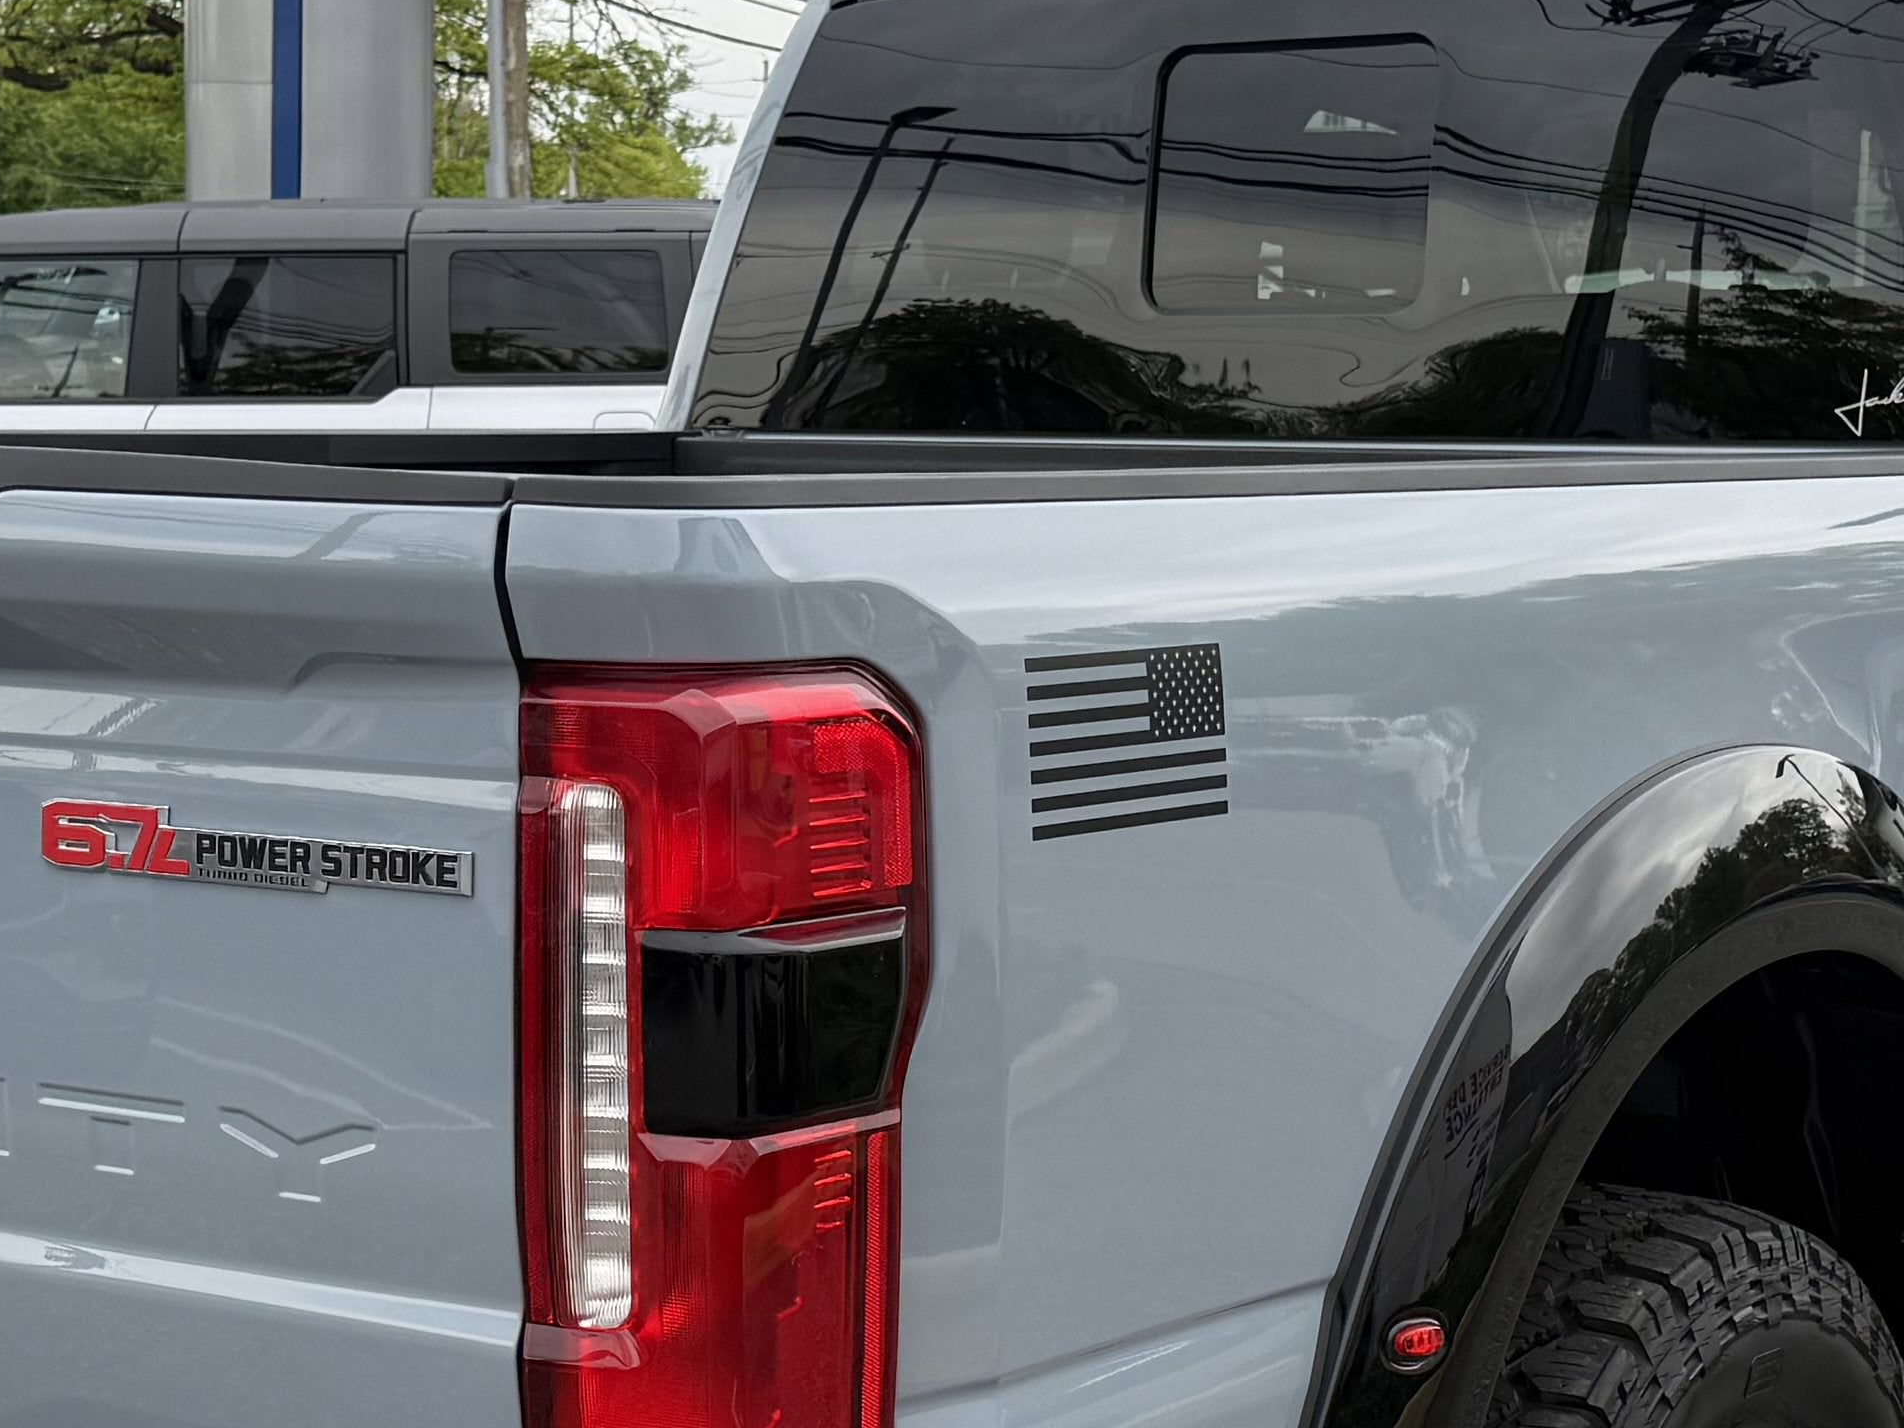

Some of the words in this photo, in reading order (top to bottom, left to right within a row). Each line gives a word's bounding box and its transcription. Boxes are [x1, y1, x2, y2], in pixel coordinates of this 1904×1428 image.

[41, 799, 191, 876] 6.7L
[197, 832, 311, 875] POWER
[320, 843, 458, 889] STROKE
[253, 871, 309, 889] DIESEL
